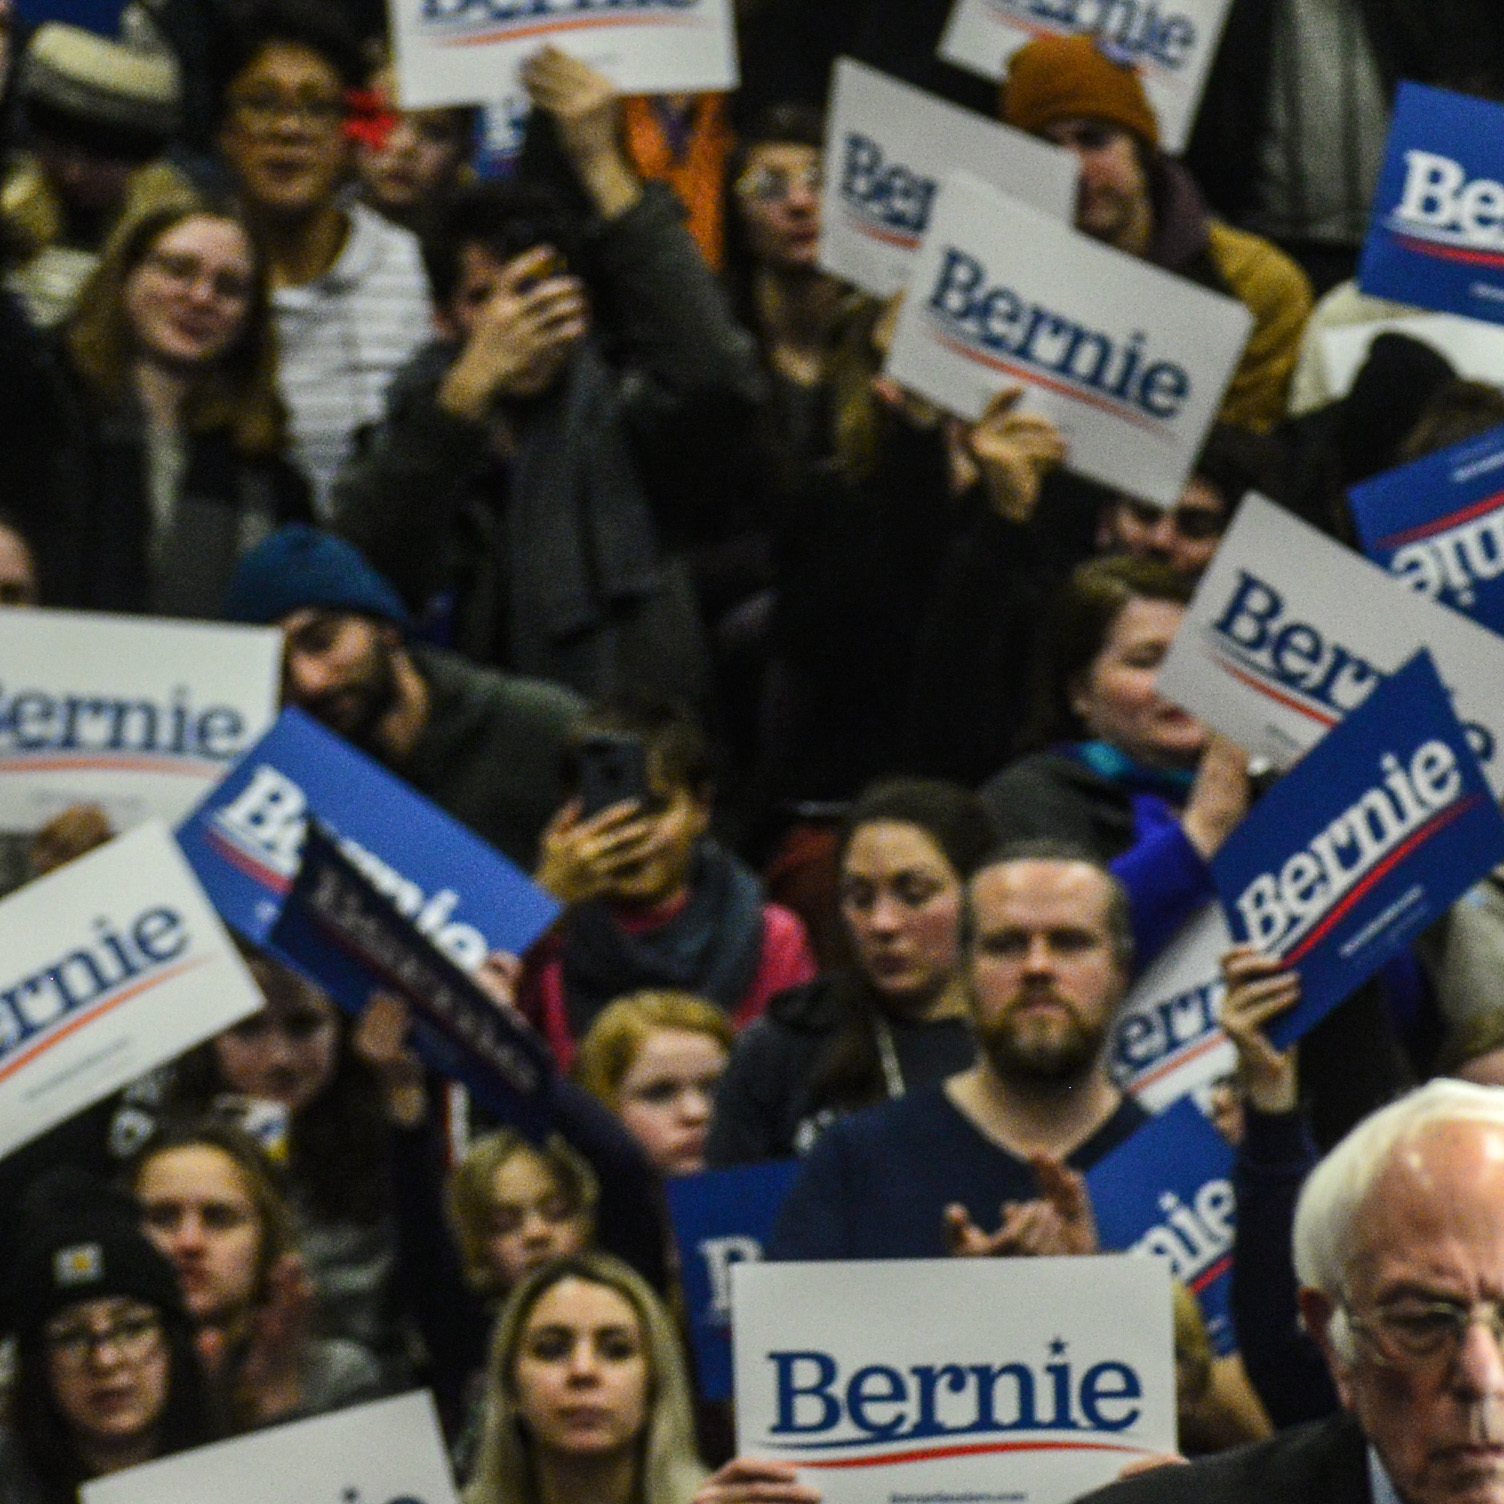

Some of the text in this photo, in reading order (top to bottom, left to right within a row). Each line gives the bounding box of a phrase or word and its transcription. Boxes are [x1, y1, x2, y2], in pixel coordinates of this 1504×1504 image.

[928, 247, 1191, 420] Bernie
[0, 683, 245, 762] ernie
[1236, 736, 1463, 950] Bernie
[767, 1337, 1141, 1438] Bernie
